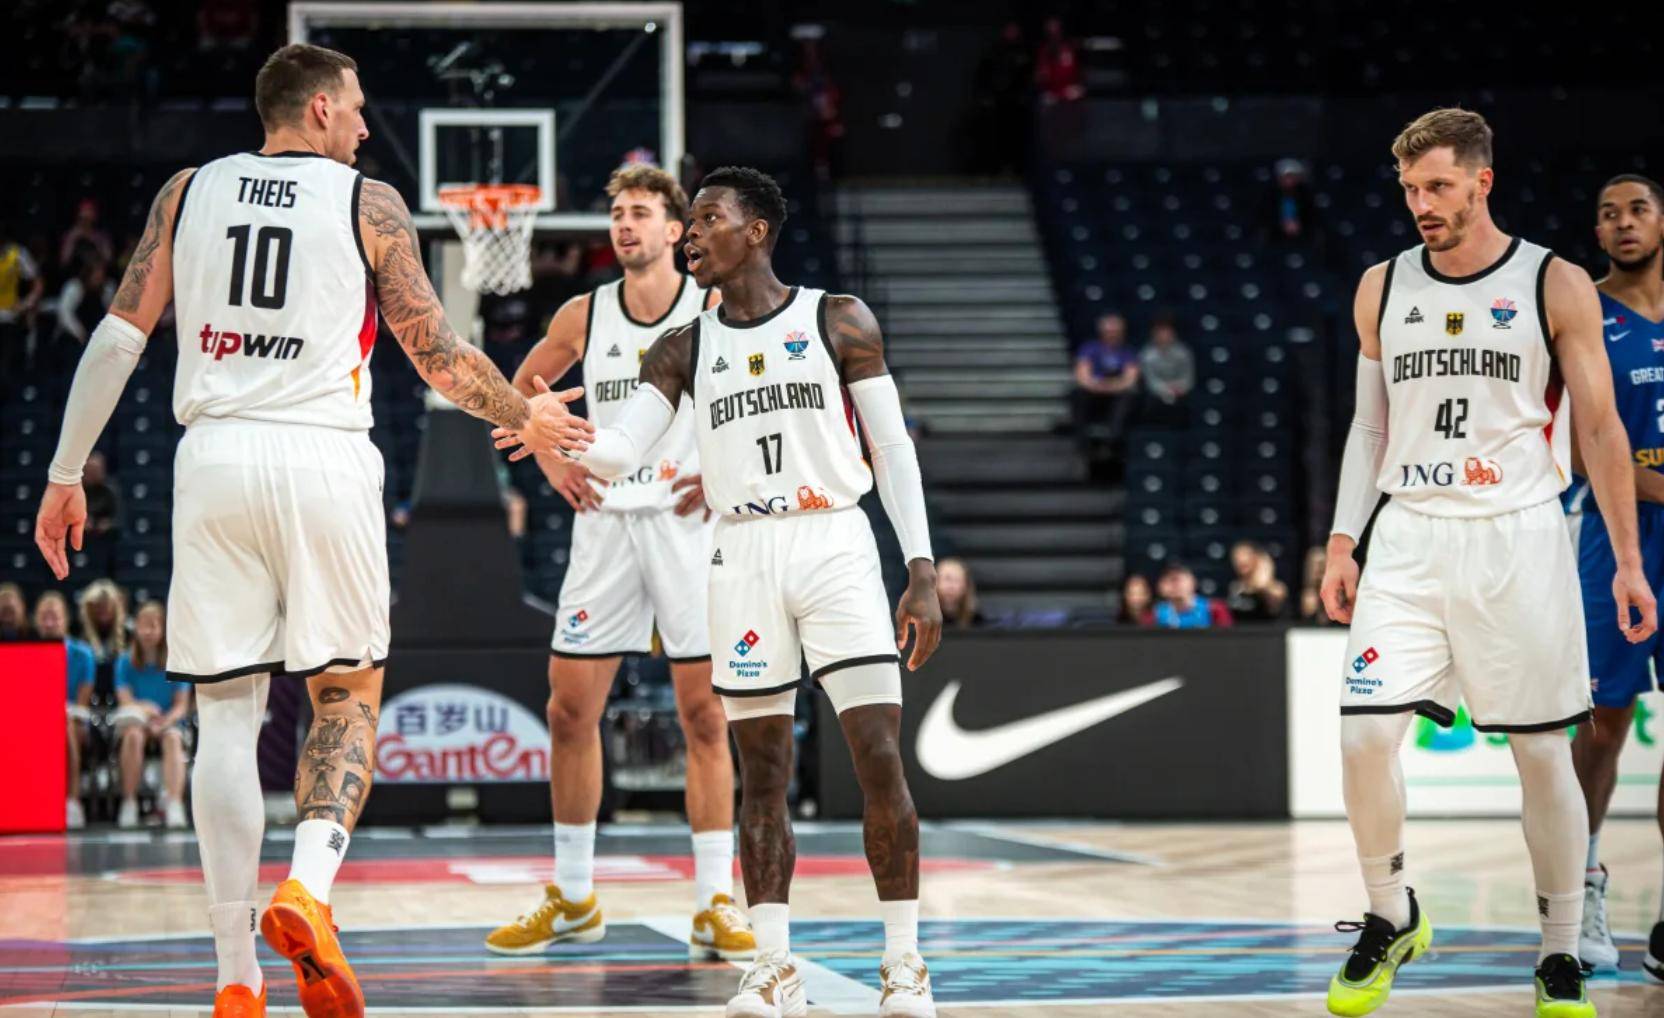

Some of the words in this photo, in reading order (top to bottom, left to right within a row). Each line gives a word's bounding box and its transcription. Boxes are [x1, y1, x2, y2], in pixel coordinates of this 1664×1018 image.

[238, 177, 297, 208] THEIS
[226, 224, 293, 310] 10
[200, 323, 304, 361] tipwin
[1393, 348, 1521, 384] DEUTSCHLAND
[709, 383, 825, 430] DEUTSCHLAND
[1434, 398, 1469, 440] 42
[756, 432, 782, 475] 17
[1401, 462, 1454, 487] ING
[729, 660, 768, 669] Domino's
[736, 669, 760, 677] Pizza
[1345, 676, 1384, 687] Domino's
[1350, 686, 1373, 695] Pizza
[396, 702, 509, 736] 百岁山
